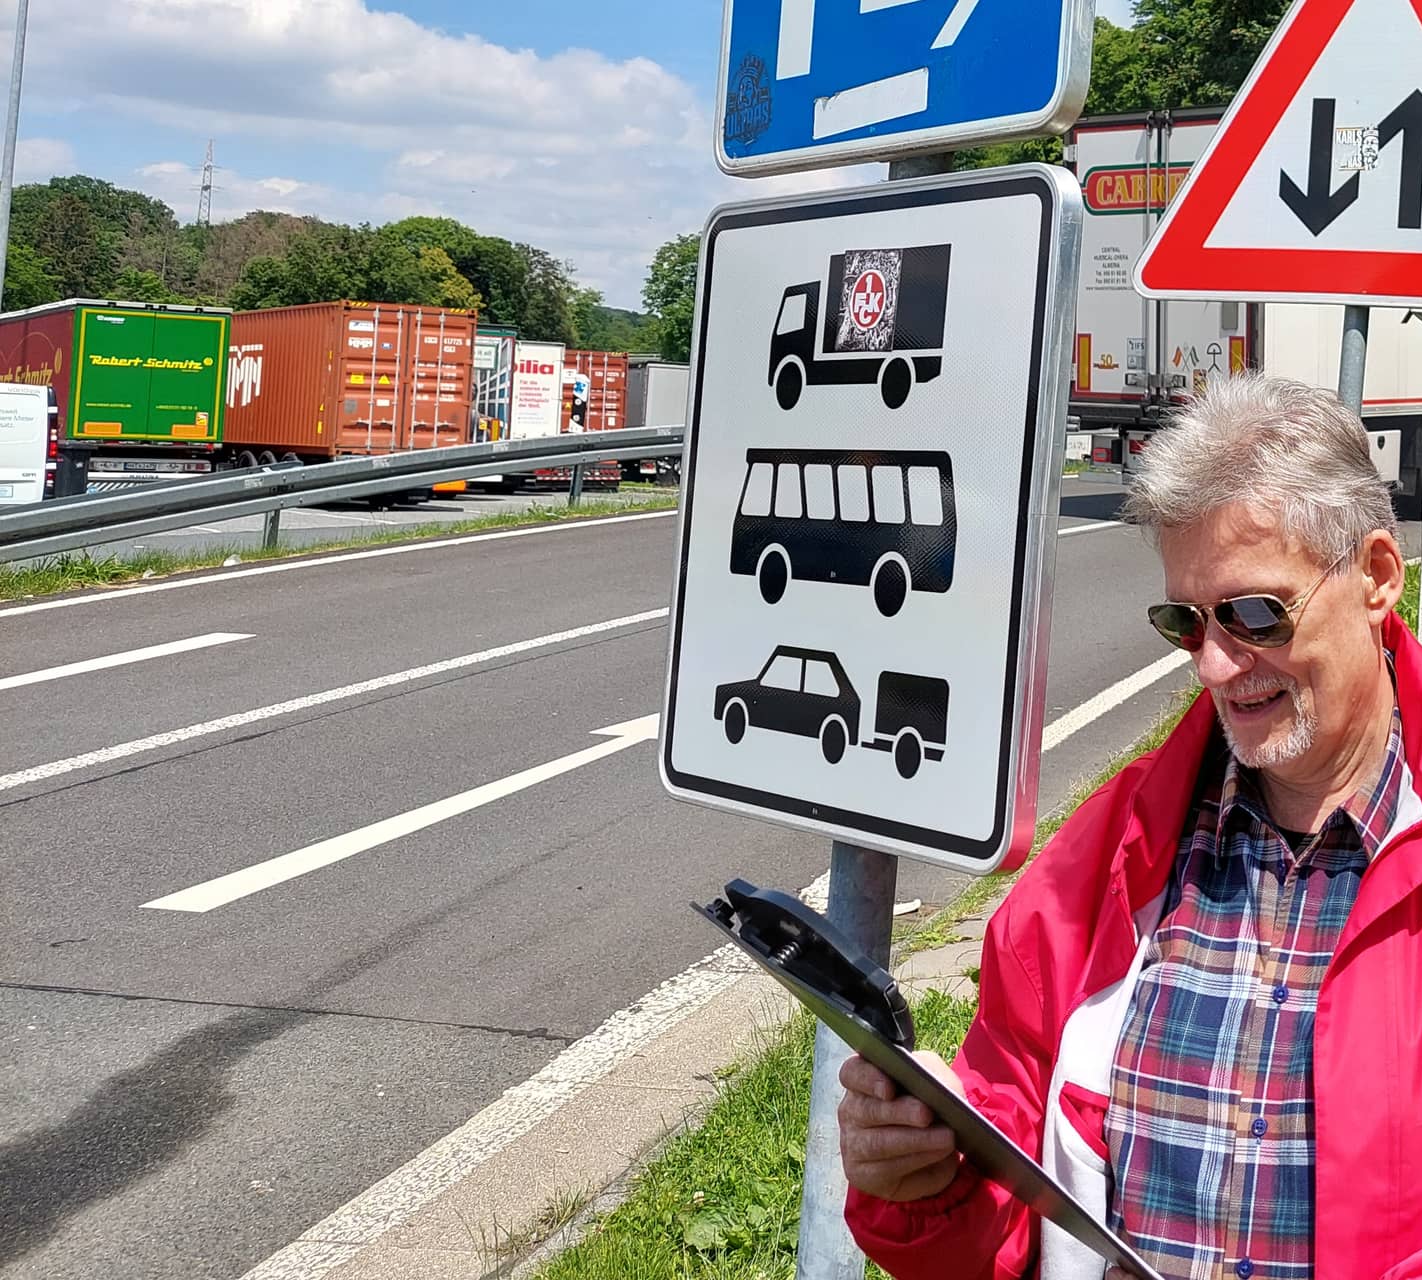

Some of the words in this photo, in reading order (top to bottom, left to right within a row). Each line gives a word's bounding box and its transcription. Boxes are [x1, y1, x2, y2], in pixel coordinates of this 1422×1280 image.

[89, 354, 143, 367] Robert
[143, 358, 203, 370] Schmitz
[513, 360, 554, 375] ilia
